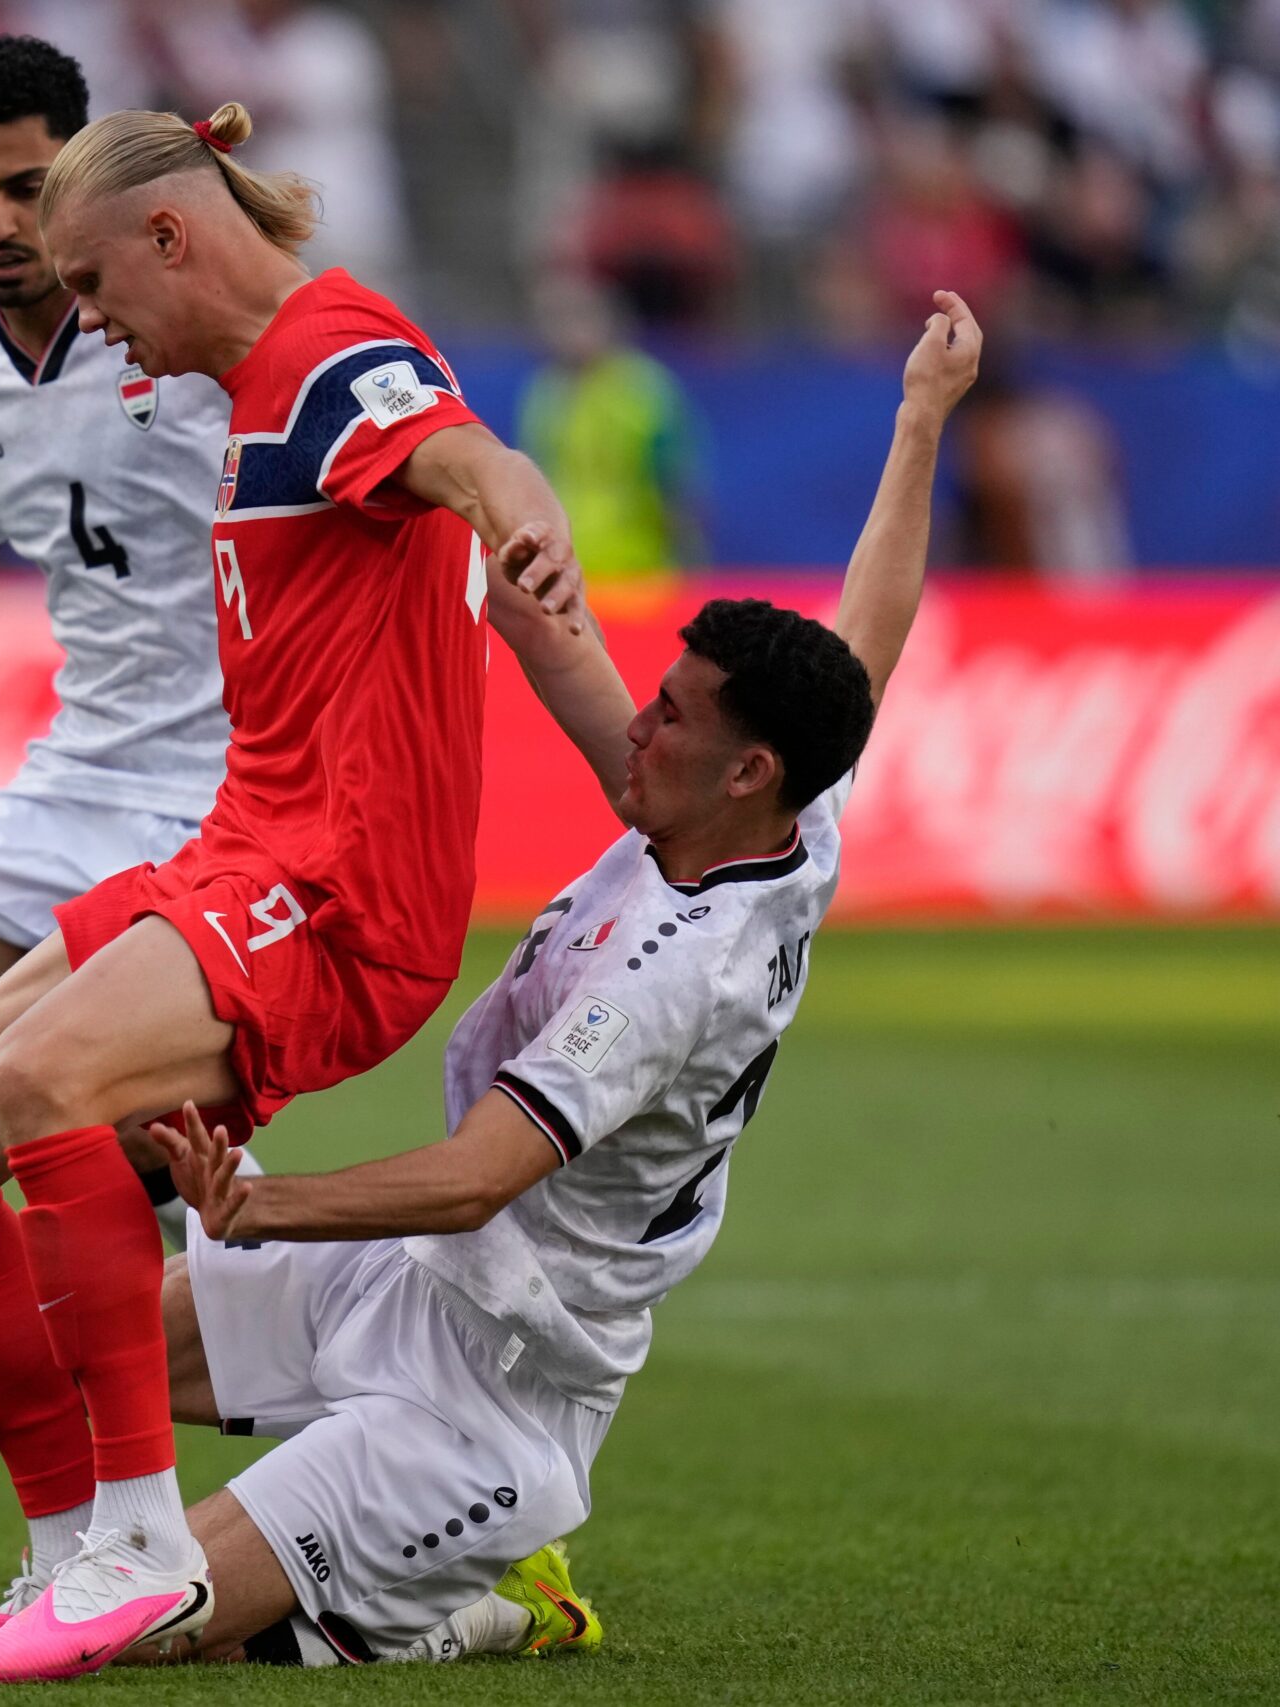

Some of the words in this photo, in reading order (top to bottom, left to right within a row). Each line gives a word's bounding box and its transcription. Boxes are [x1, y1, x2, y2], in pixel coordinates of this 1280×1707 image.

[388, 390, 415, 414] PEACE
[70, 481, 131, 579] 4
[215, 539, 253, 640] 9
[247, 882, 308, 953] 9
[767, 929, 810, 1015] ZAI
[562, 1044, 577, 1057] FIFA
[563, 1033, 593, 1054] PEACE
[295, 1532, 331, 1583] JAKO
